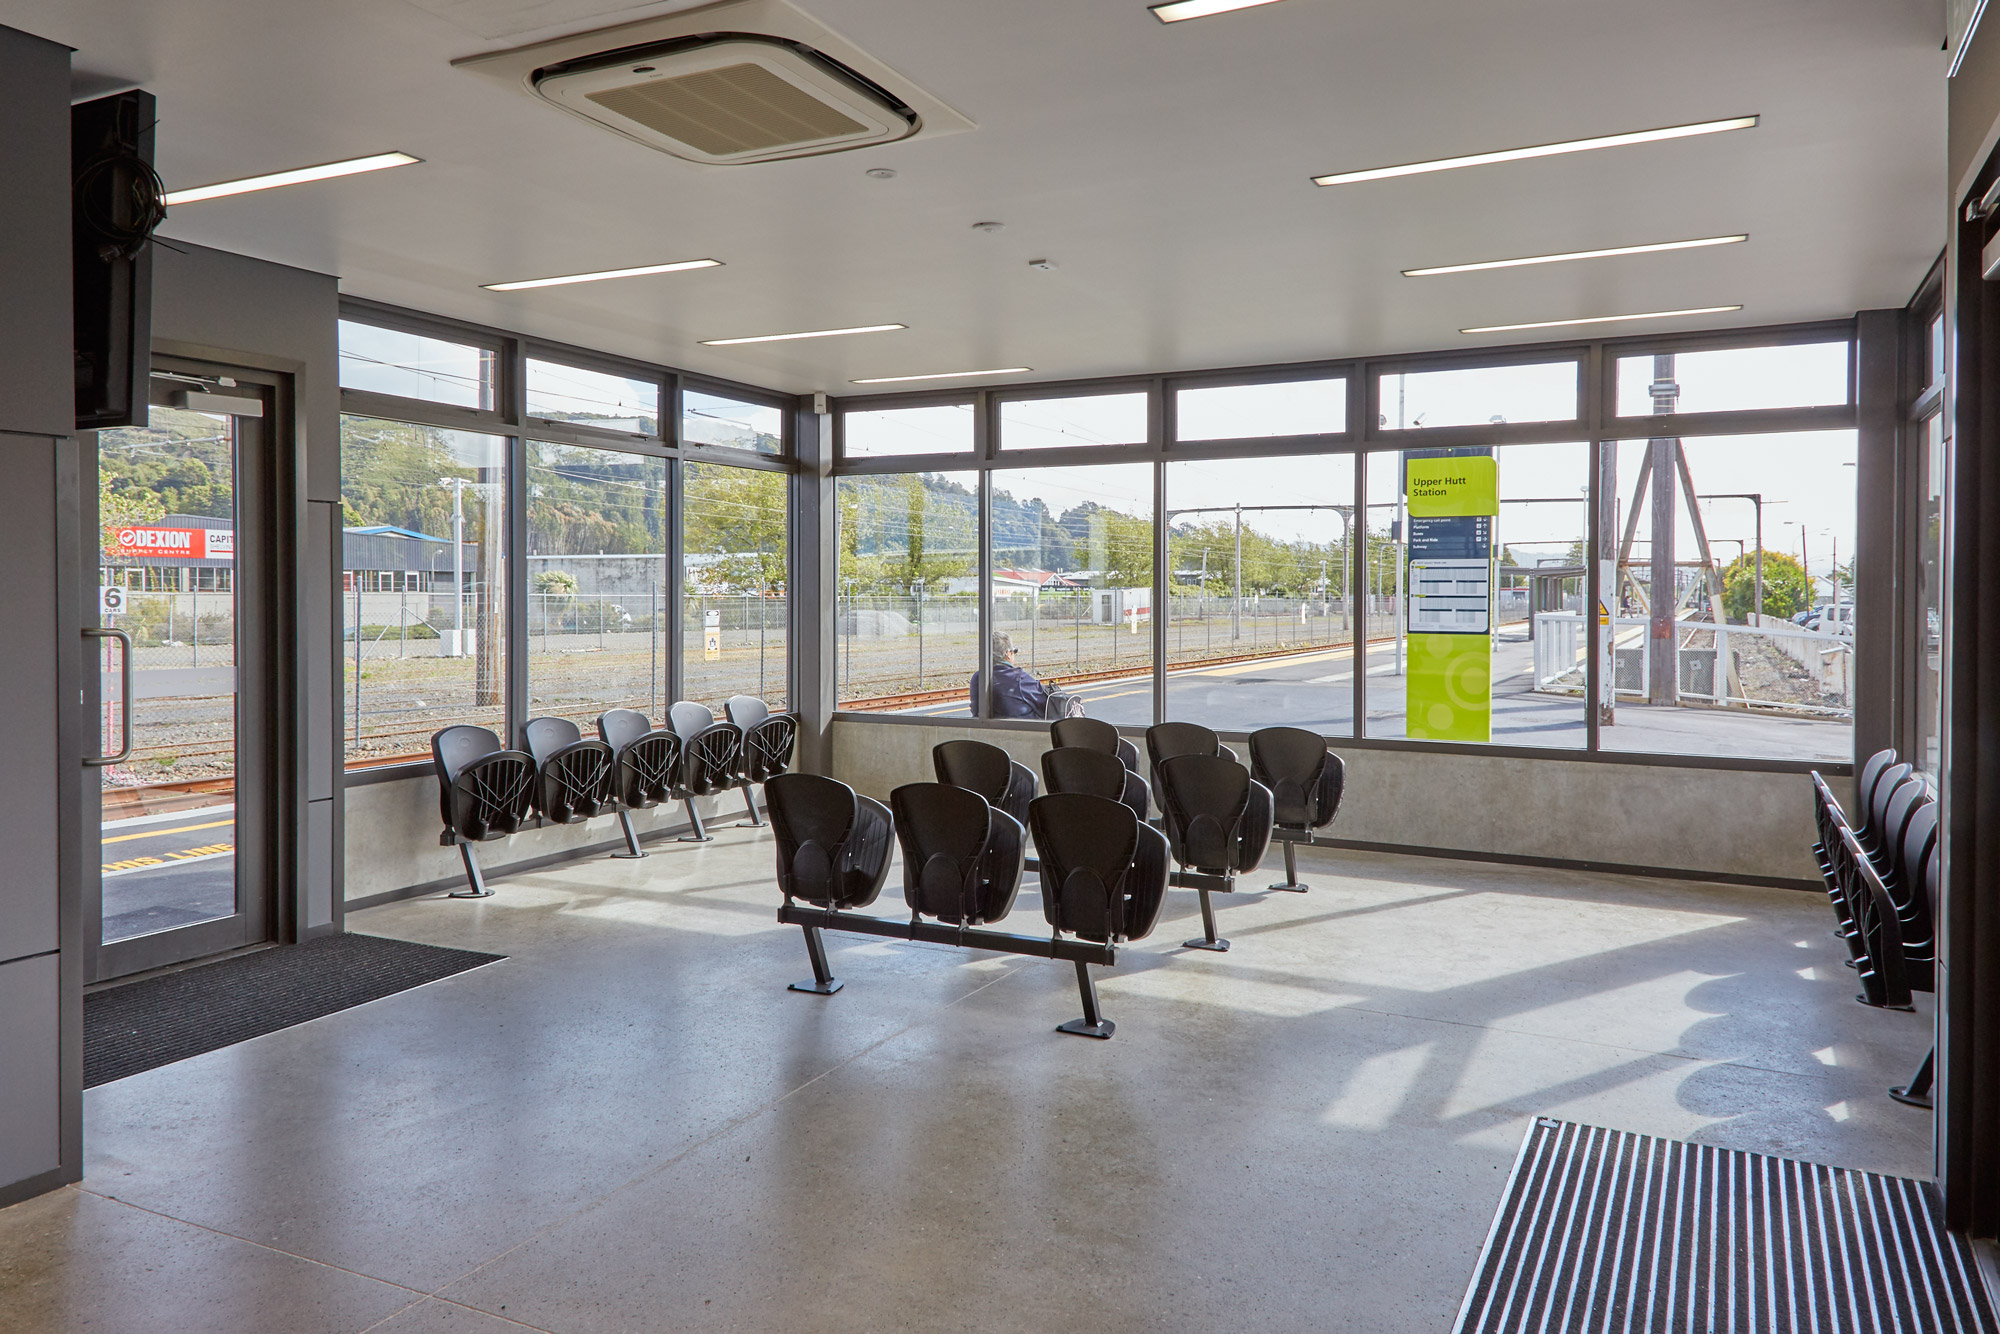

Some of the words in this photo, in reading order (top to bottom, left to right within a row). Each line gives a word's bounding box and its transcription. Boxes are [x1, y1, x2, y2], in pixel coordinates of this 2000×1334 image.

[1413, 478, 1442, 487] Upper
[1445, 477, 1466, 485] Hutt
[1413, 488, 1446, 496] Station
[135, 530, 190, 548] DEXION
[104, 587, 121, 608] 6
[101, 856, 165, 873] HIS
